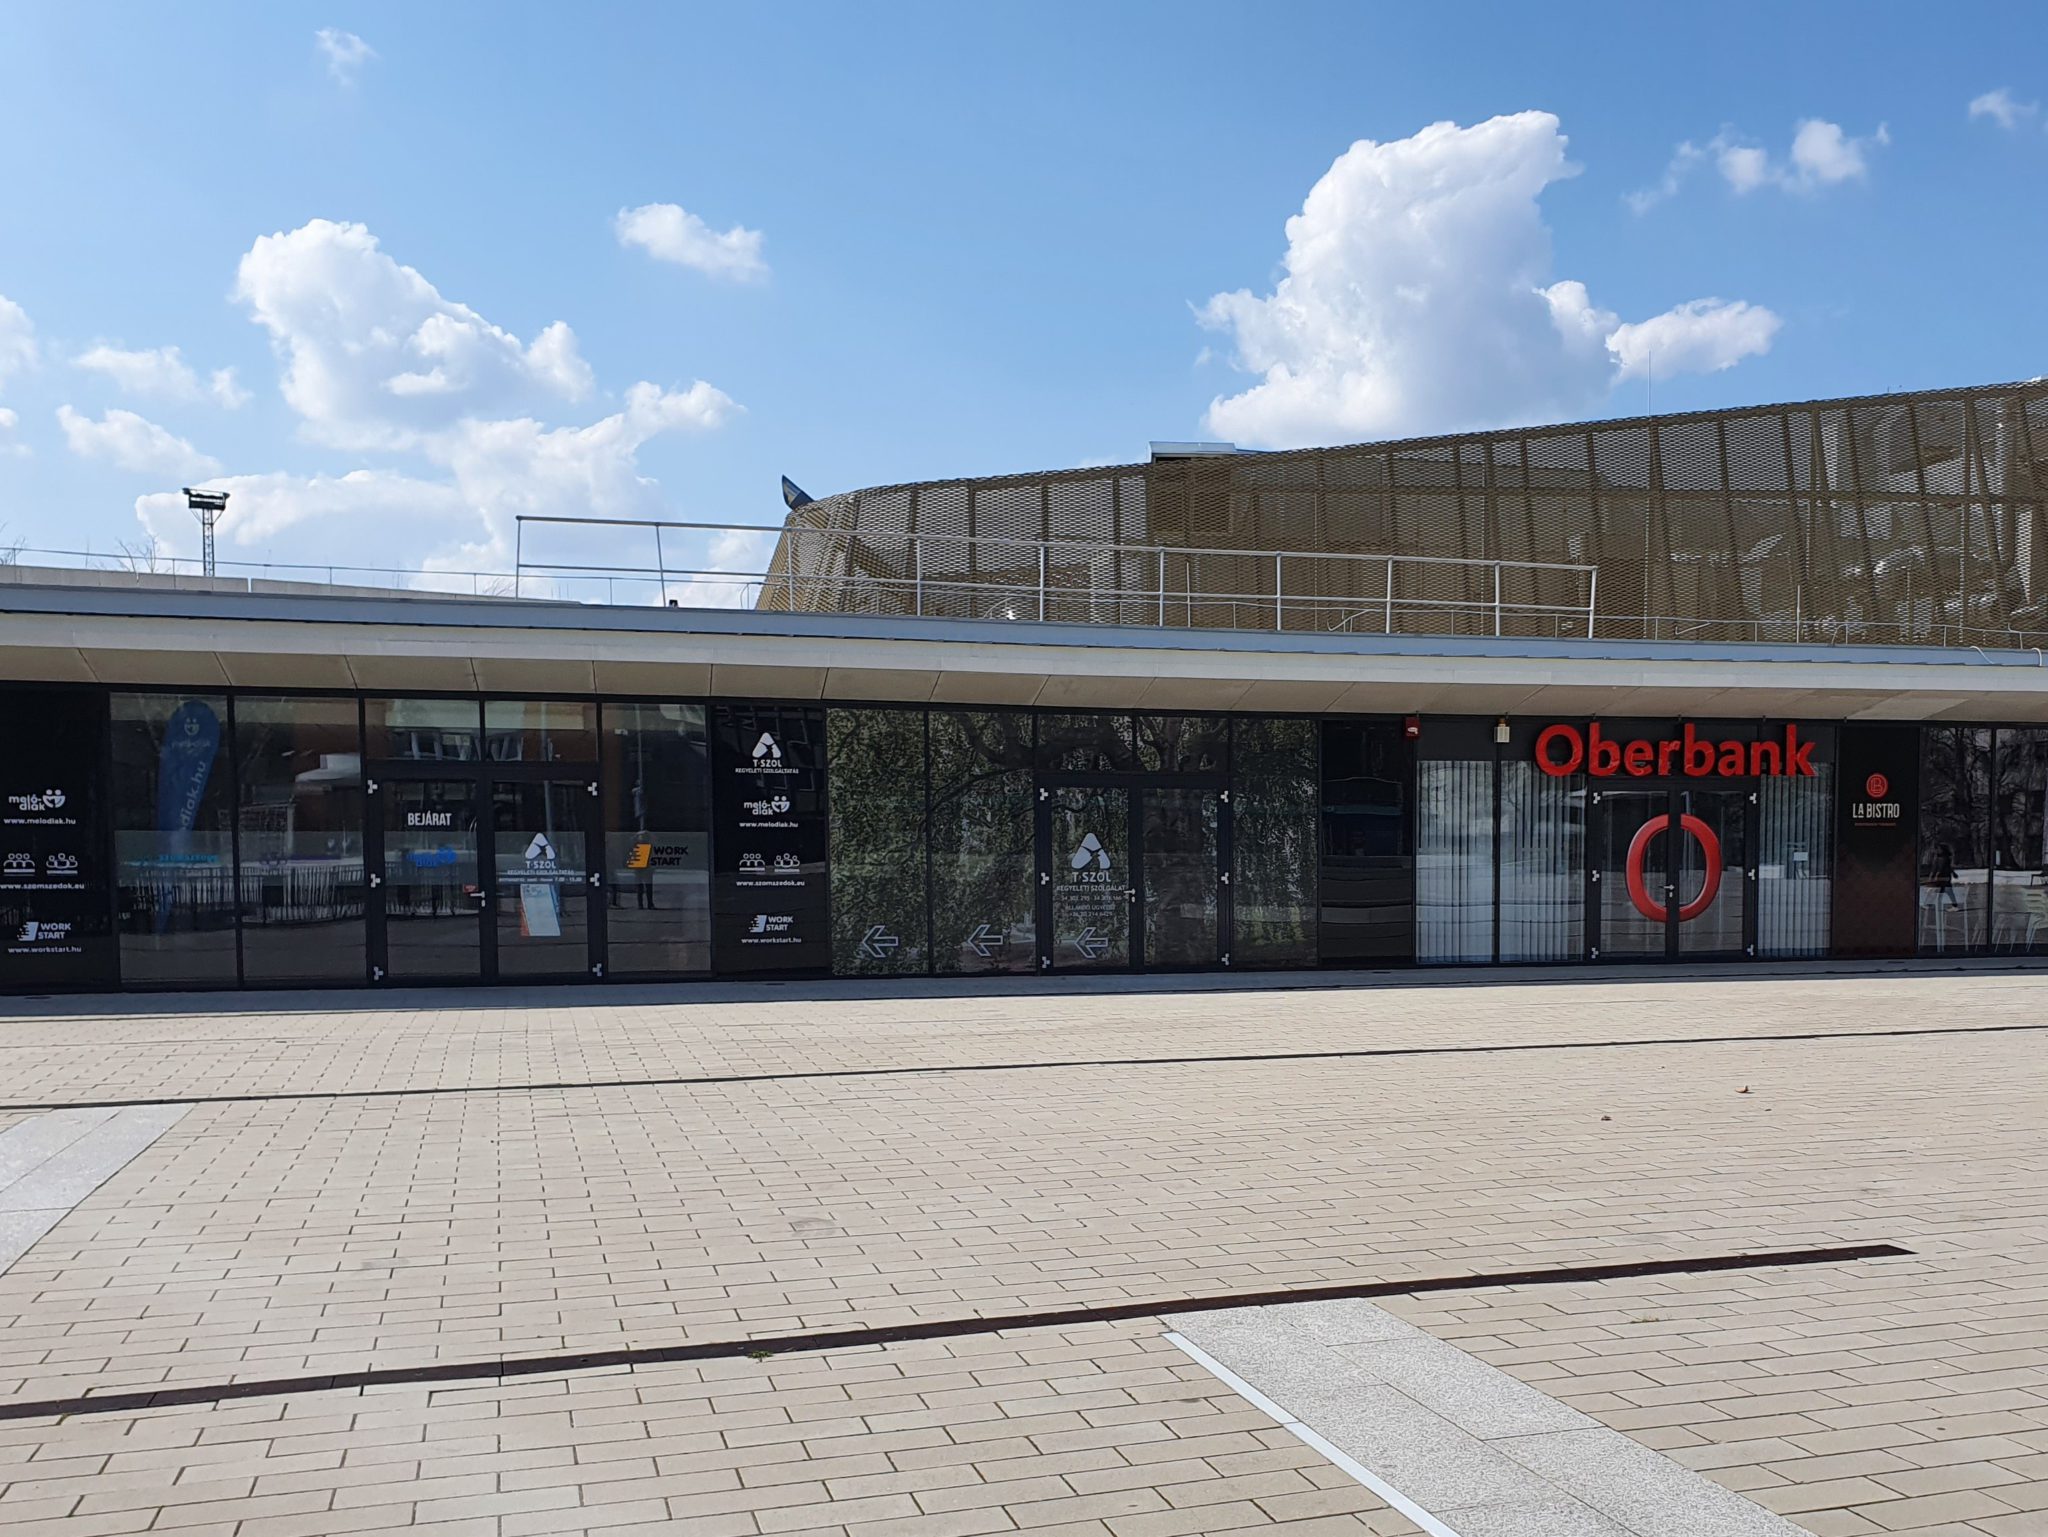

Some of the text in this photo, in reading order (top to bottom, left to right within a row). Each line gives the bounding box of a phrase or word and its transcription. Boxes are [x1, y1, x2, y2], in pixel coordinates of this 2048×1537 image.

[1535, 721, 1817, 777] Oberbank
[1852, 803, 1900, 818] LA BISTRO
[3, 817, 77, 825] www.melodiak.hu
[407, 810, 452, 826] BEJÁRAT
[653, 846, 689, 855] WORK
[650, 857, 681, 866] START
[768, 915, 793, 923] WORK
[40, 922, 72, 931] WORK
[766, 923, 788, 931] START
[38, 931, 65, 940] START
[8, 945, 82, 953] www.workstart.hu
